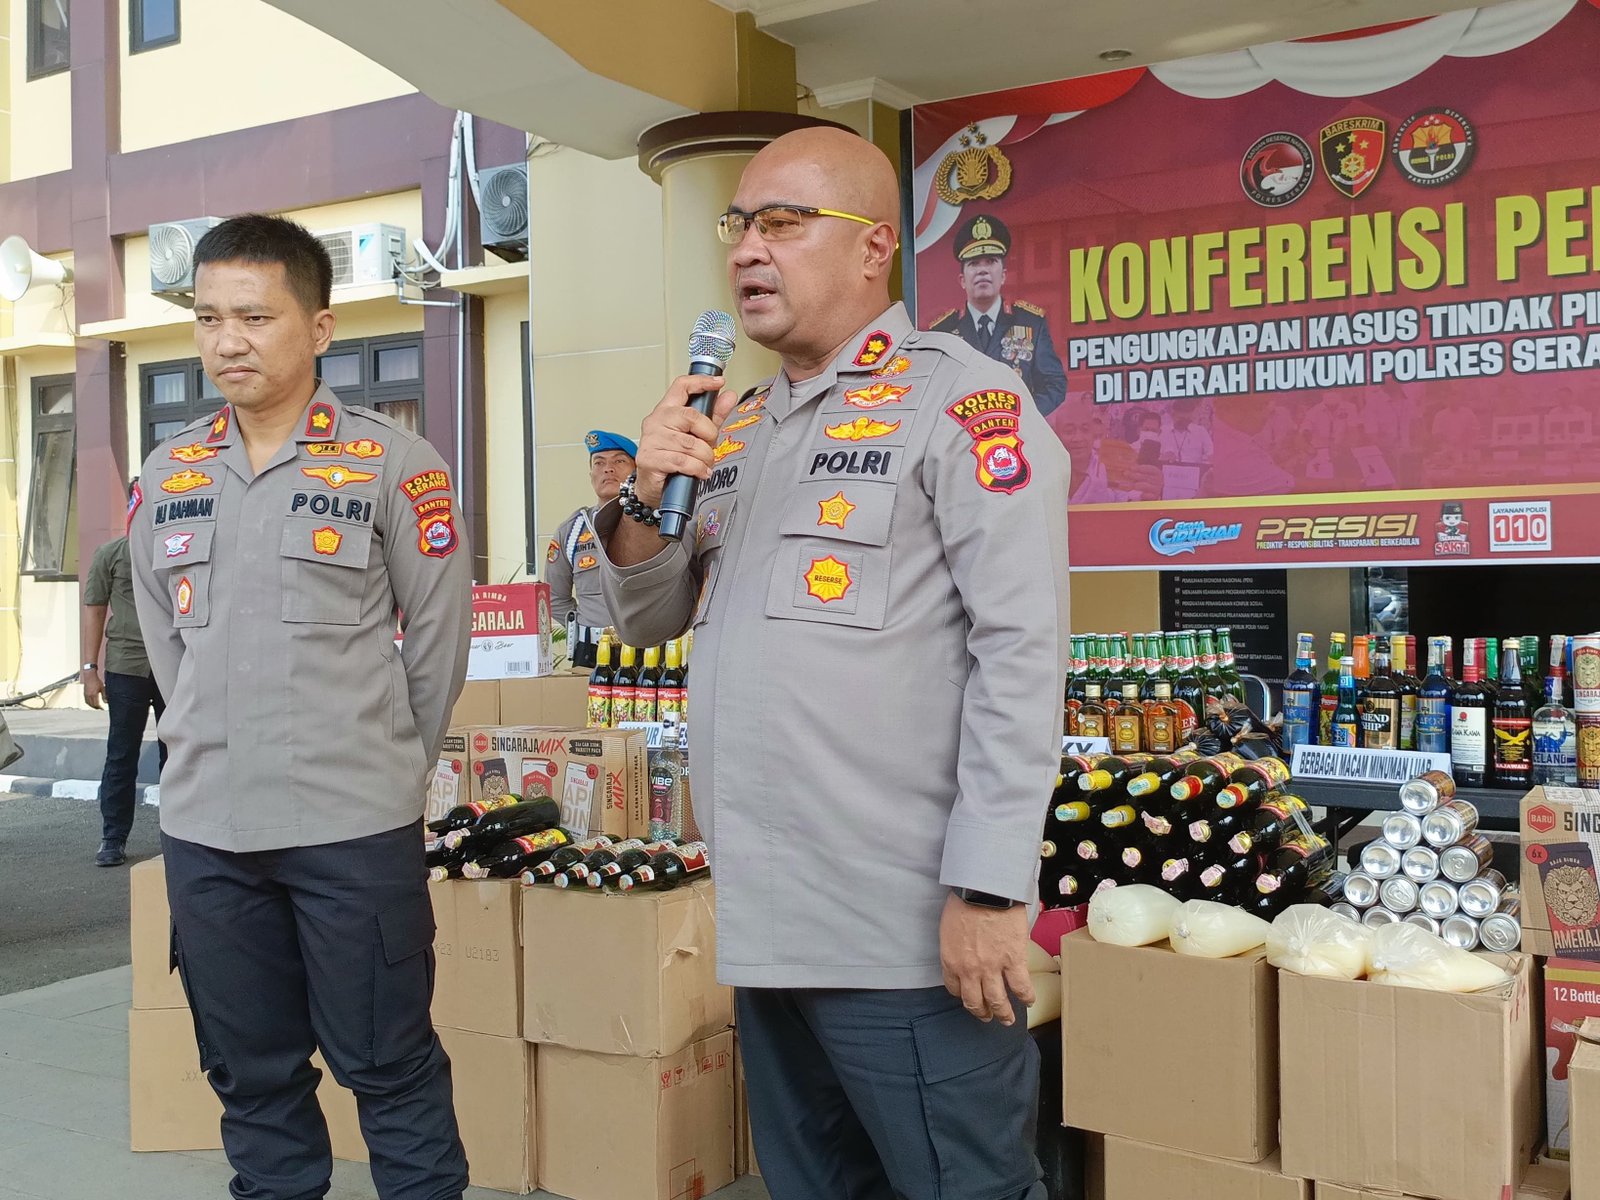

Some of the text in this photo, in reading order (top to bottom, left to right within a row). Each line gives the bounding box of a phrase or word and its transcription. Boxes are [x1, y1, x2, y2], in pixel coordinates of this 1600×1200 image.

[1325, 119, 1381, 138] BARESKRIM
[1069, 185, 1600, 323] KONFERENSI PE
[1069, 290, 1600, 369] PENGUNGKAPAN KASUS TINDAK PI
[1095, 333, 1600, 403] DI DAERAH HUKUM POLRES SERA
[953, 390, 1016, 416] POLRES
[964, 401, 1013, 418] SERANG
[973, 418, 1015, 434] BANTEN
[809, 450, 892, 476] POLRI
[404, 472, 446, 492] POLRES
[410, 479, 447, 497] SERANG
[698, 465, 738, 499] ONDRO
[169, 497, 214, 521] RAHMAN
[291, 493, 371, 522] POLRI
[418, 500, 449, 513] BANTEN
[1161, 524, 1242, 545] CIDURIAN
[1256, 514, 1418, 540] PRESISI
[1495, 516, 1546, 540] 110
[1256, 537, 1420, 549] PREDIKTIF RESPONSIBILITAS TRANSPARANSI BERKEADILAN
[1435, 541, 1469, 555] SAKTI
[814, 574, 843, 585] RESERSE
[483, 591, 507, 602] RIMBA
[1464, 728, 1481, 737] KAWA
[491, 736, 538, 753] SINGARAJA
[537, 736, 567, 756] MIX
[1299, 751, 1337, 775] BERBAGAI
[1340, 753, 1367, 778] MACAM
[1368, 755, 1408, 780] MINUMAN
[612, 767, 625, 810] MIX
[1531, 814, 1553, 824] BARU
[1531, 848, 1542, 858] 6x
[1553, 929, 1600, 949] AMERAJ
[1553, 986, 1567, 1002] 12
